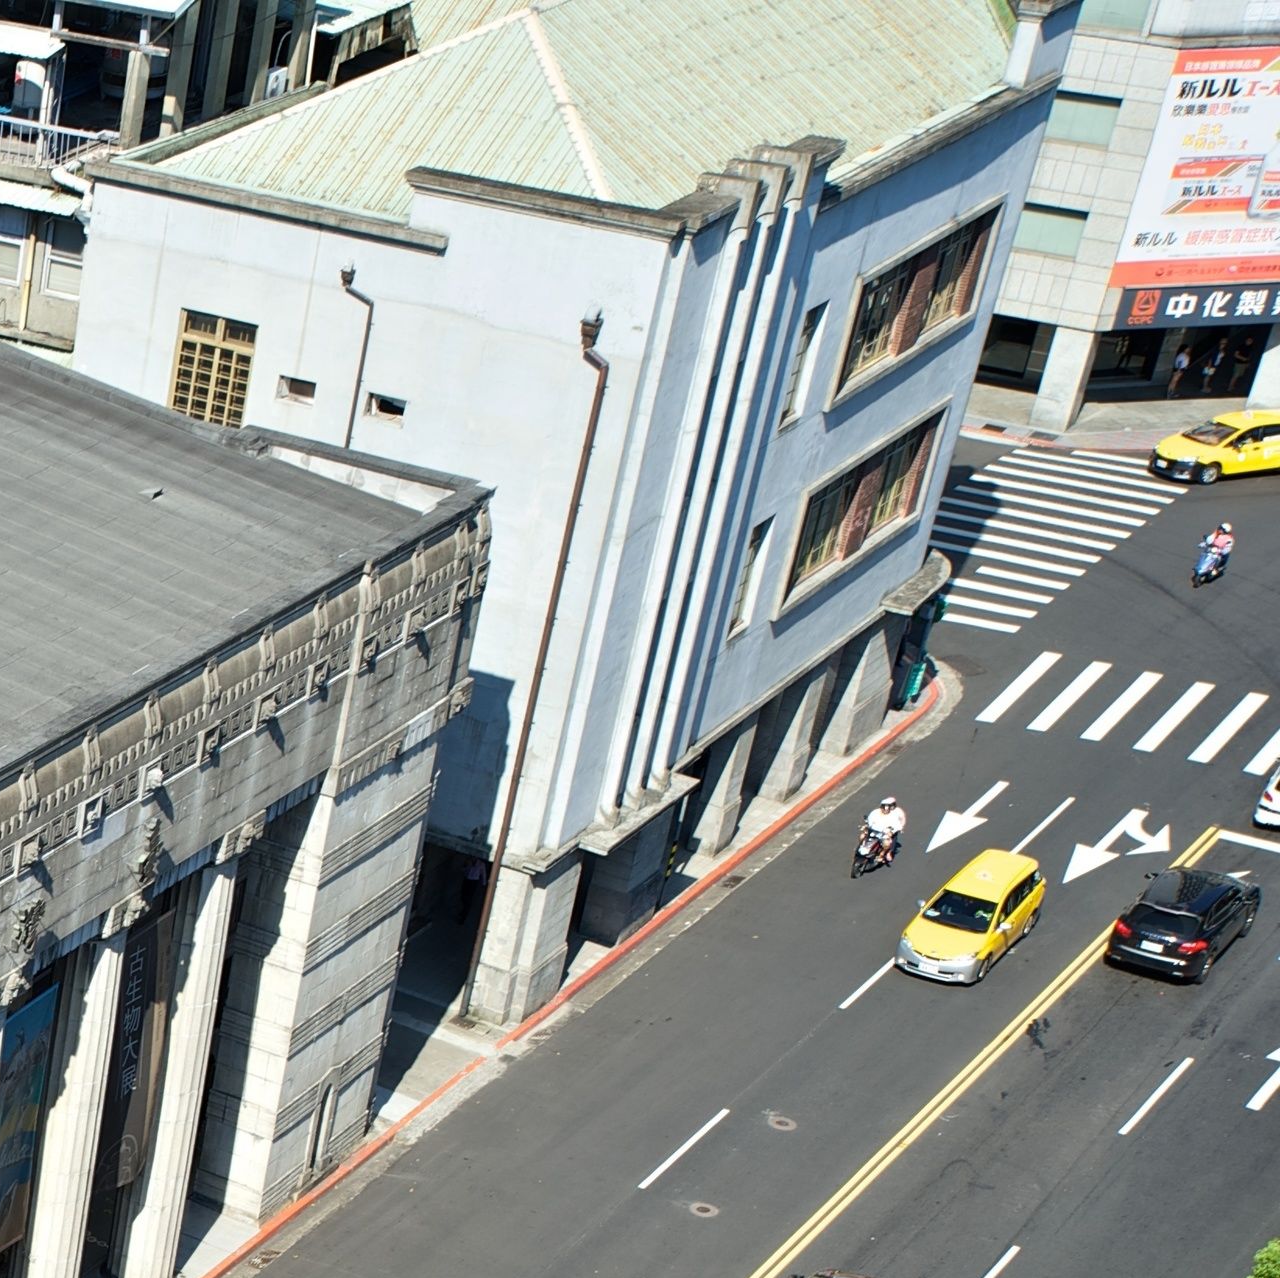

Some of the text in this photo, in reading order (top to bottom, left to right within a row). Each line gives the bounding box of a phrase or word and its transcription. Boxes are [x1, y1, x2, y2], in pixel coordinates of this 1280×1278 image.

[120, 944, 146, 1099] 古生物大展
